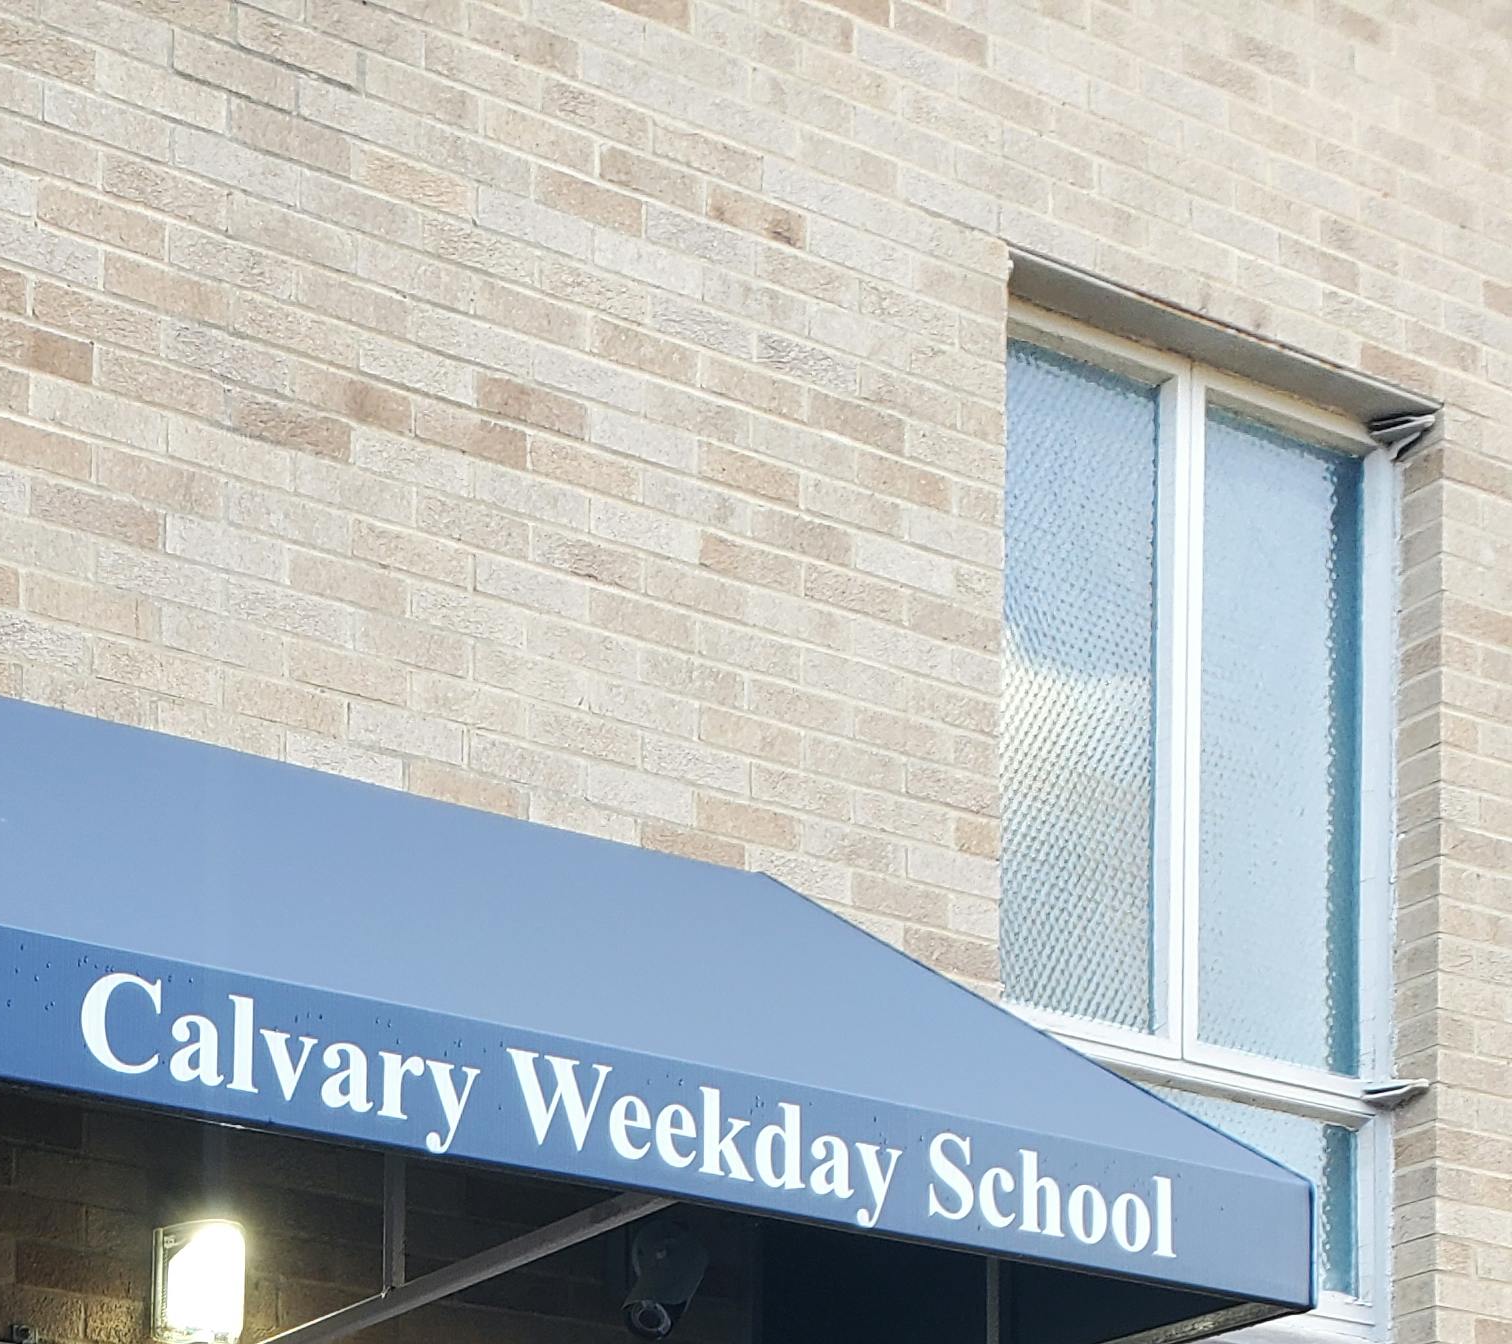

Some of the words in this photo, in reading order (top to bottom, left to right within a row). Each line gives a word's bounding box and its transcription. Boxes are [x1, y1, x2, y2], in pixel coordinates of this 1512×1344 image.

[80, 973, 481, 1154] Calvary
[505, 1046, 903, 1229] Weekday
[926, 1132, 1178, 1259] School
